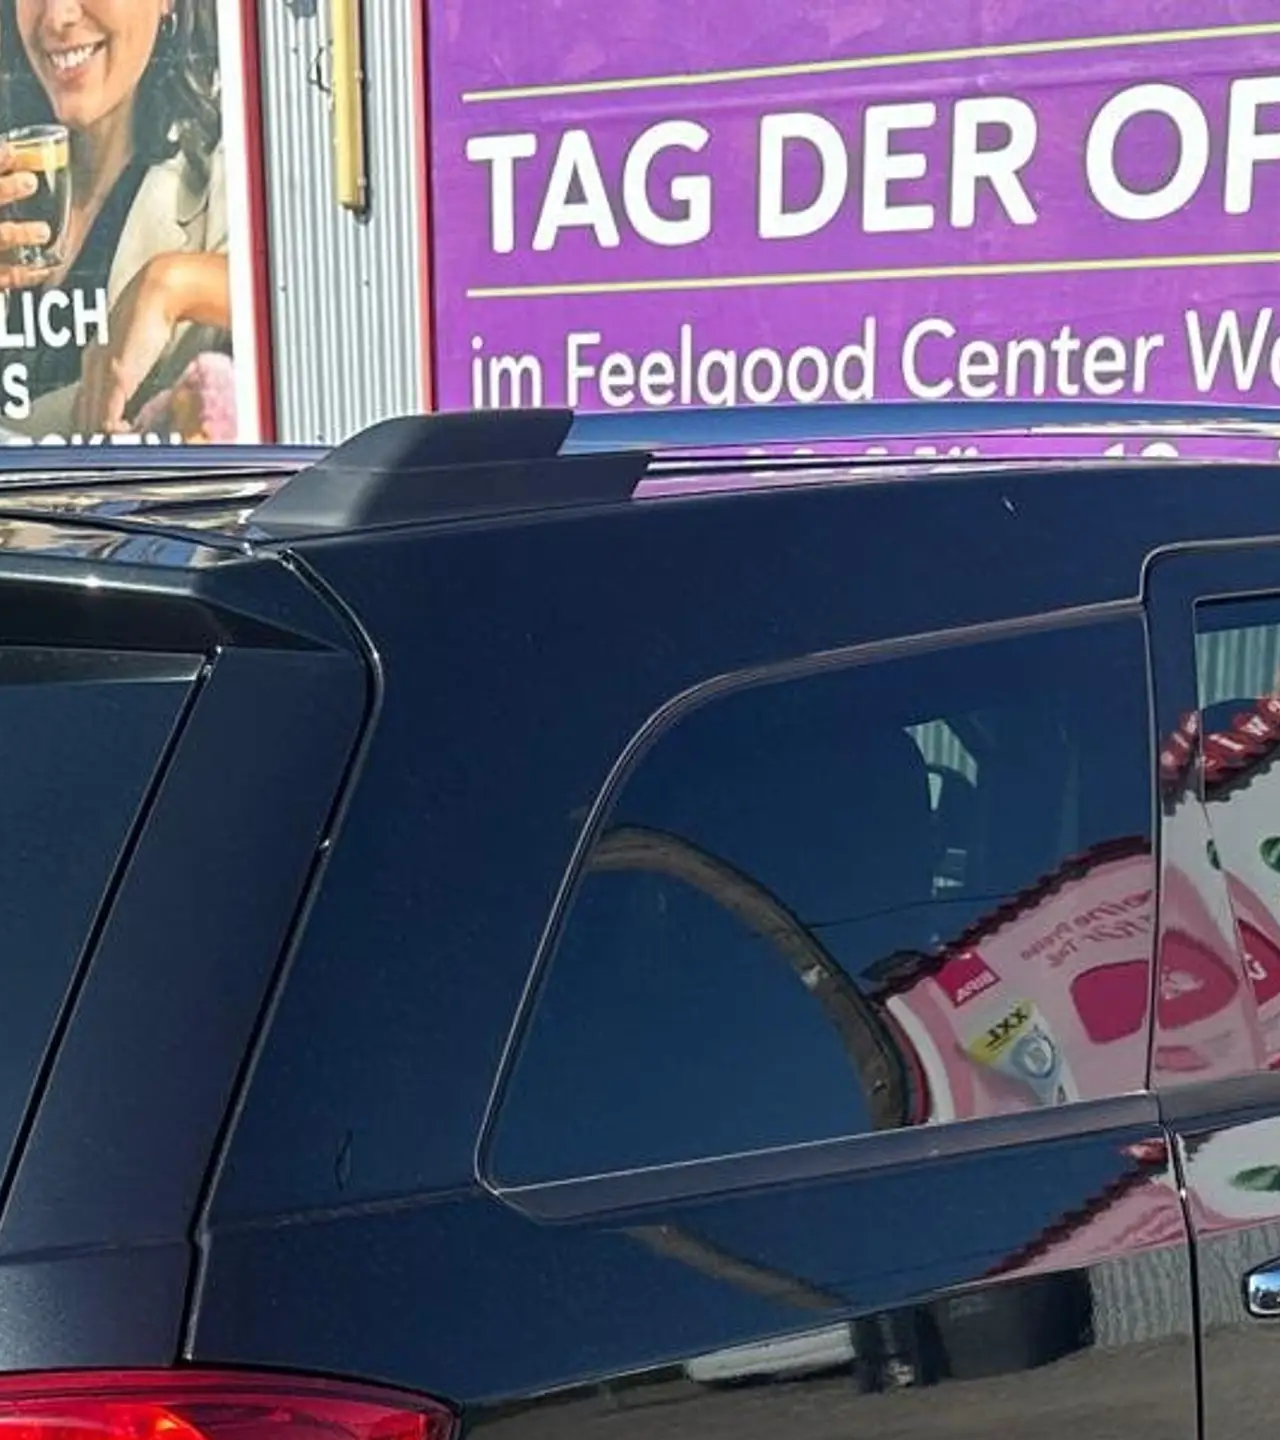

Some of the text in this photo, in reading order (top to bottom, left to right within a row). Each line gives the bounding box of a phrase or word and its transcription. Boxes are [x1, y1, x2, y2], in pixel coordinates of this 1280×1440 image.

[466, 121, 713, 255] TAG
[758, 97, 1038, 240] DER
[471, 335, 542, 410] im
[567, 317, 876, 407] Feelgood
[902, 319, 1164, 401] Center
